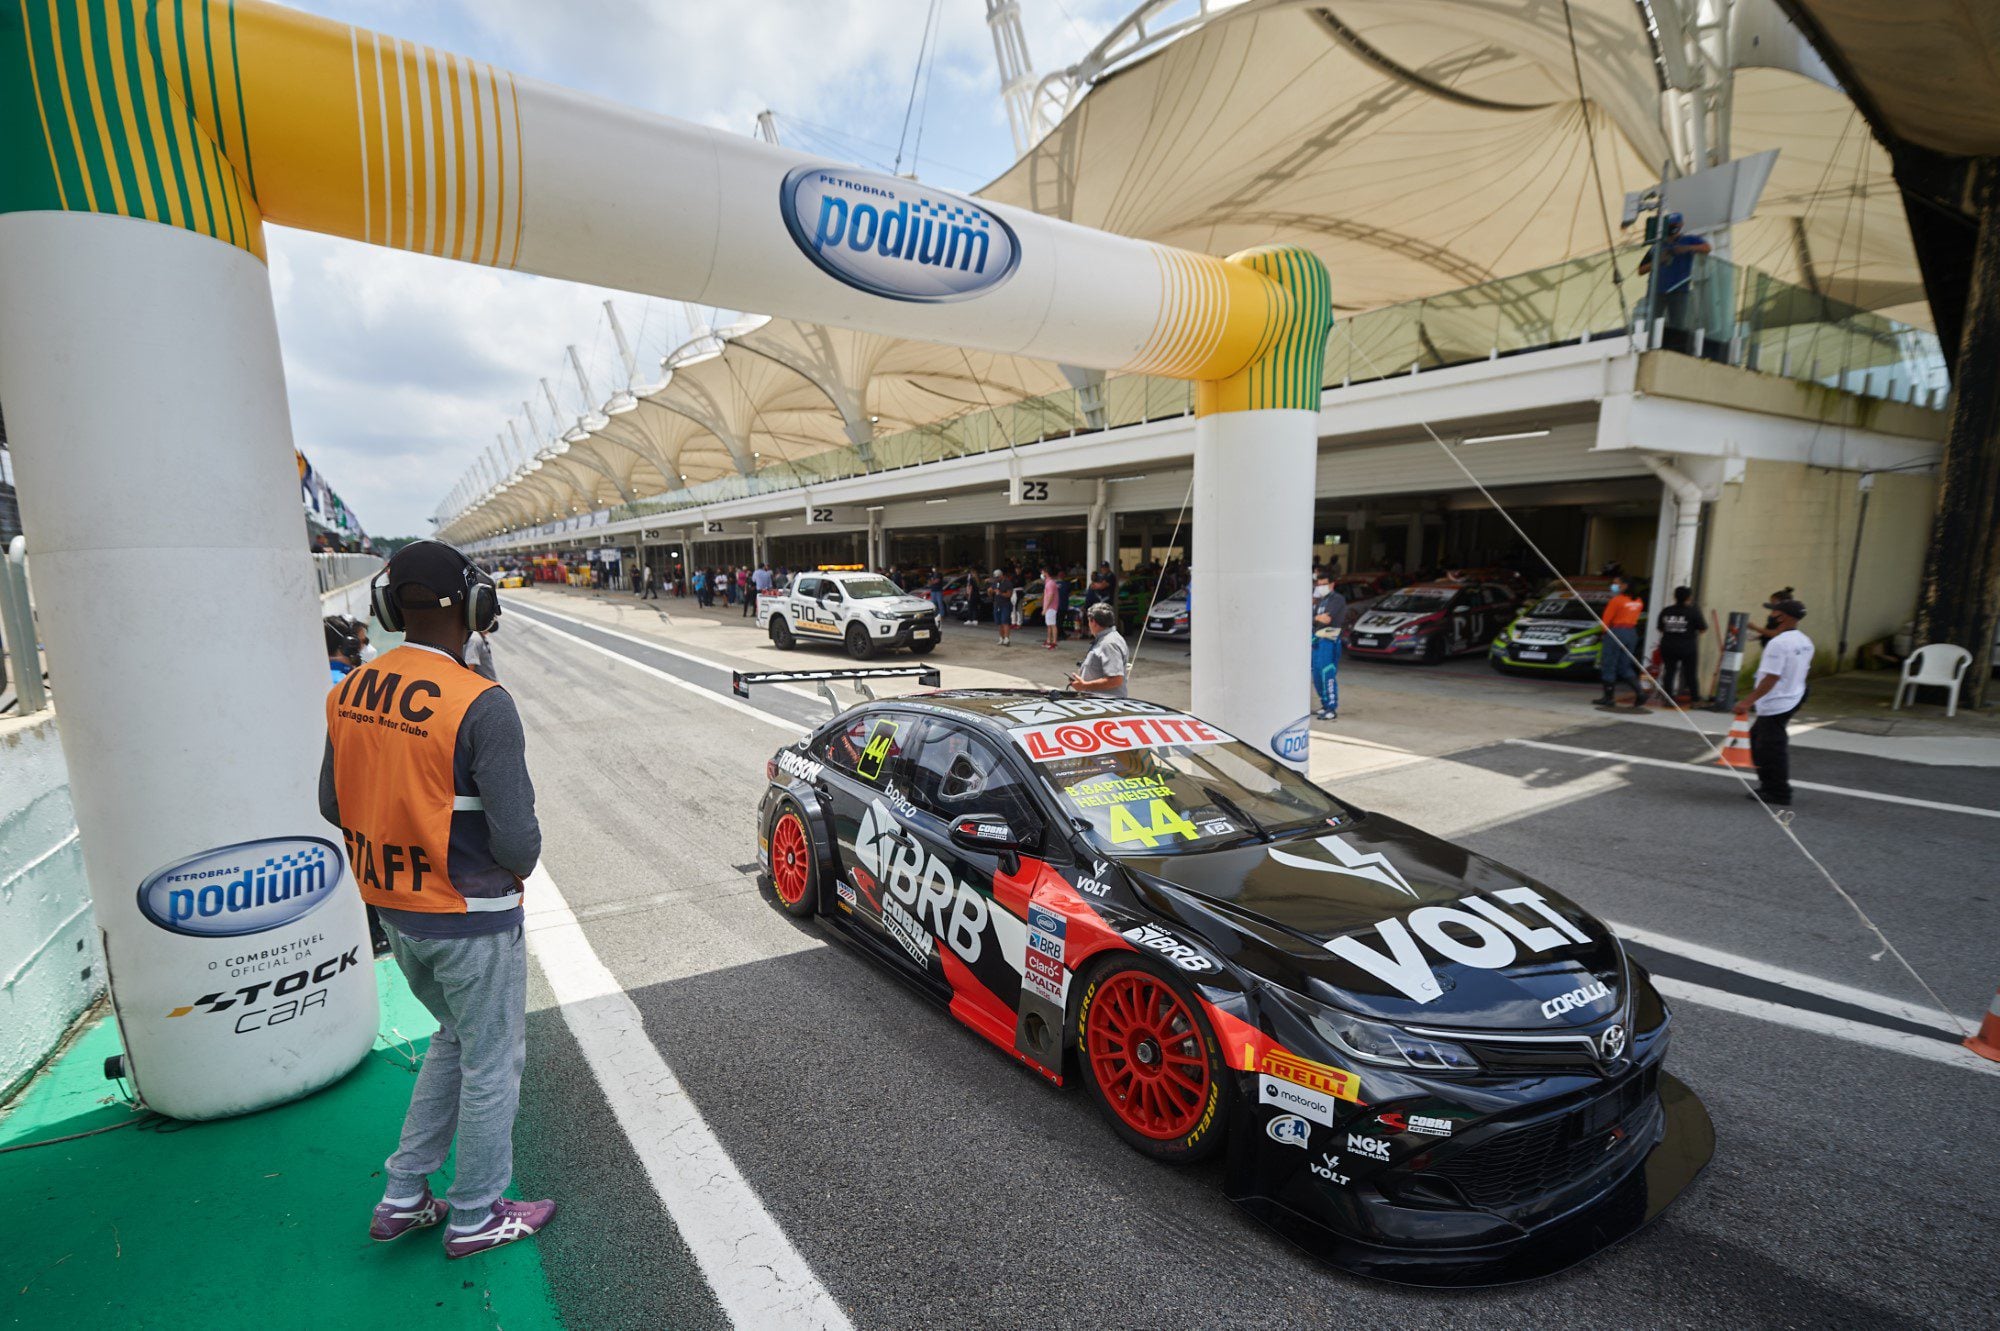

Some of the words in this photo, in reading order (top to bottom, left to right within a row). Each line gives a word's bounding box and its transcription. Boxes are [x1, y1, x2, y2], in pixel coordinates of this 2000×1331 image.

[819, 174, 895, 200] PETROBRAS
[813, 195, 990, 274] podium
[1023, 482, 1048, 500] 23
[708, 522, 724, 533] 21
[813, 509, 834, 522] 22
[603, 535, 615, 543] 19
[645, 530, 660, 539] 20
[338, 668, 442, 723] IMC
[1055, 699, 1167, 716] BRB
[378, 716, 399, 730] Motor
[400, 722, 429, 738] Clube
[1024, 718, 1218, 760] LOCTITE
[865, 735, 890, 764] 44
[1283, 730, 1309, 756] pod
[778, 750, 824, 785] TEROSON
[1076, 786, 1176, 809] HELLMEISTER
[978, 824, 1008, 836] COBRA
[1109, 799, 1201, 847] 44
[341, 826, 432, 892] STAFF
[167, 865, 241, 883] PETROBRAS
[1076, 875, 1112, 898] VOLT
[169, 858, 327, 927] podium
[889, 829, 988, 964] BRB
[881, 891, 934, 956] COBRA
[207, 960, 218, 971] O
[225, 933, 325, 967] COMBUSTÍVEL
[883, 914, 928, 969] AUTOMOTIVA
[1040, 937, 1062, 959] BRB
[1148, 932, 1212, 971] BRB
[1322, 886, 1593, 1005] VOLT
[231, 956, 289, 978] OFICIAL
[295, 949, 313, 961] DA
[1029, 956, 1055, 978] Claro
[193, 945, 360, 1014] STOCK
[1025, 971, 1062, 999] AXALTA
[1078, 981, 1096, 1036] ZERO
[1541, 980, 1612, 1021] COROLLA
[1187, 1081, 1220, 1148] PIRELLI
[1280, 1089, 1328, 1114] motorola
[1274, 1119, 1306, 1141] CBA
[1408, 1115, 1452, 1130] COBRA
[1346, 1146, 1368, 1156] SPARK
[1368, 1151, 1390, 1162] PLUGS
[1347, 1132, 1392, 1157] NGK
[1310, 1162, 1350, 1186] VOLT
